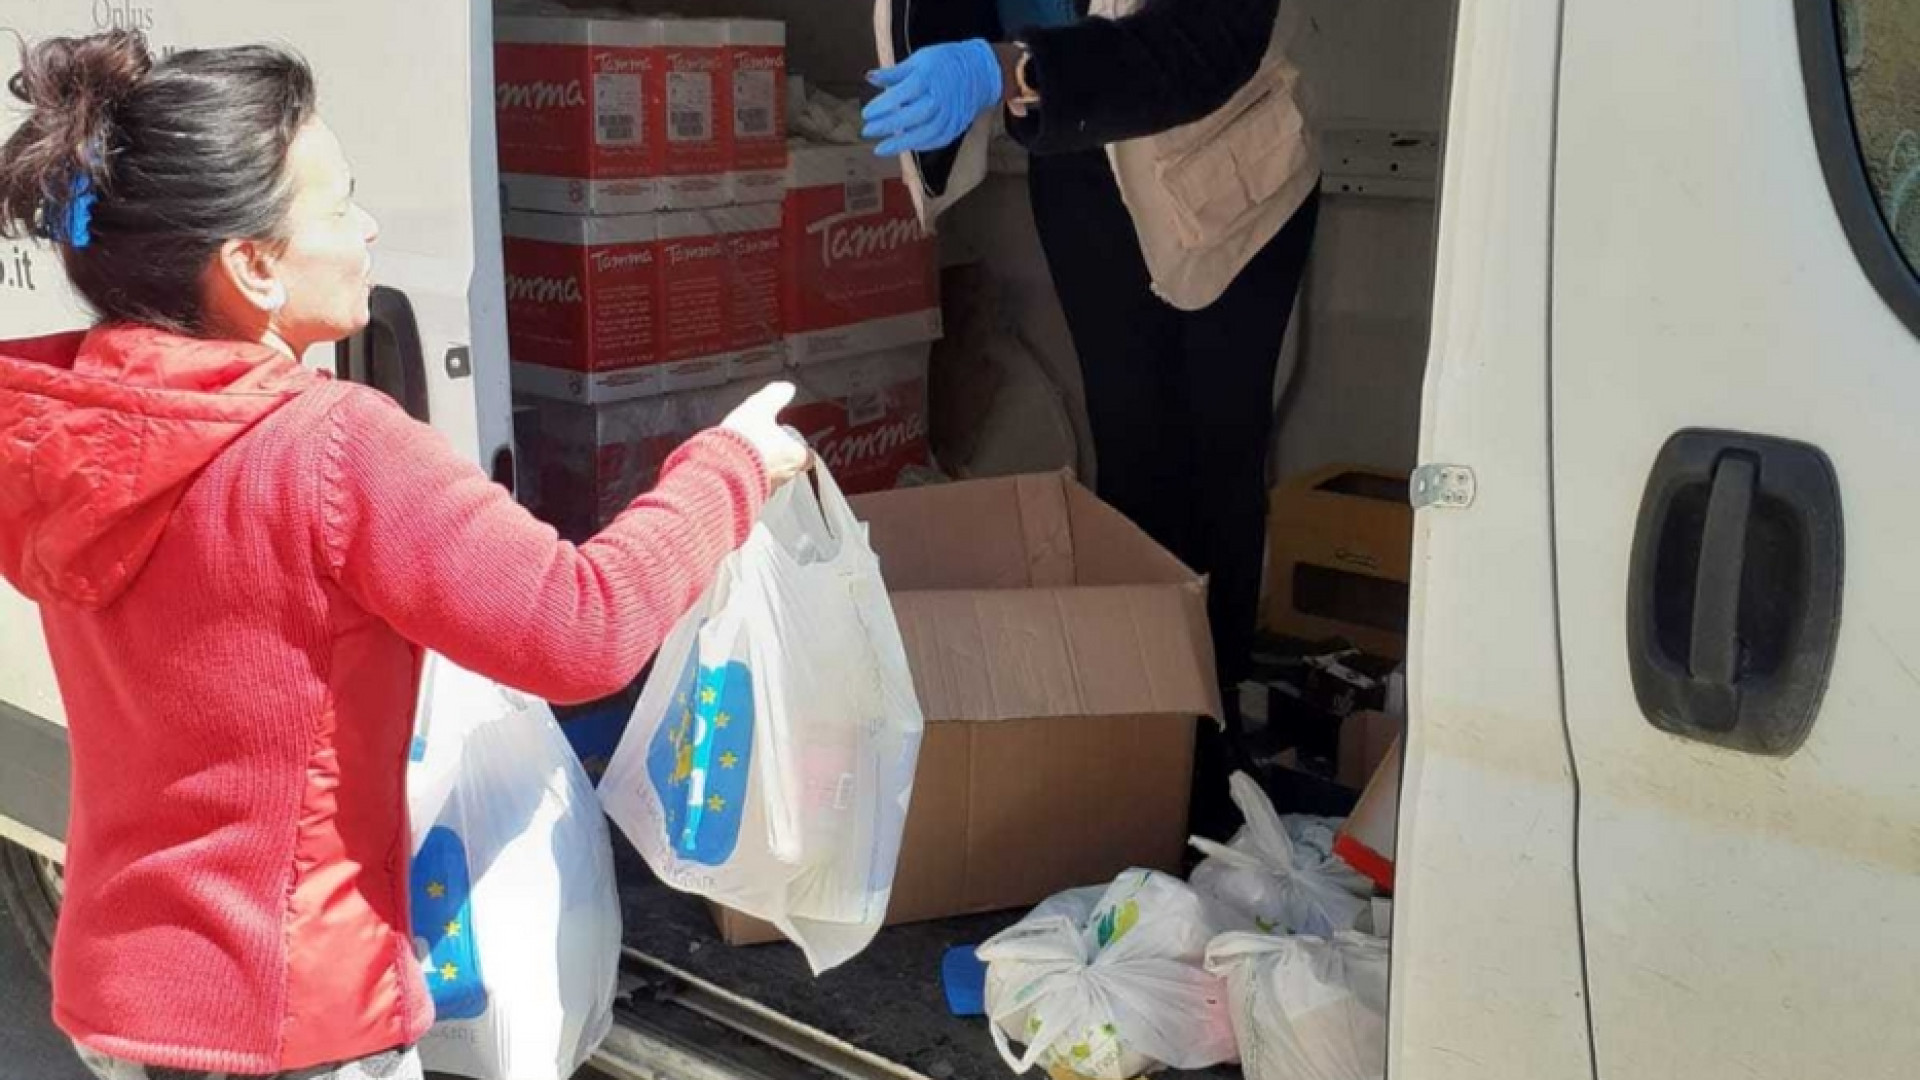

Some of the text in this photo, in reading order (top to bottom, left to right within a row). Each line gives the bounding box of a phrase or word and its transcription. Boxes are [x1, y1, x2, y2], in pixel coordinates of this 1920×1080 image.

[497, 79, 586, 109] mma
[806, 212, 937, 269] Tamm
[507, 274, 582, 302] mma
